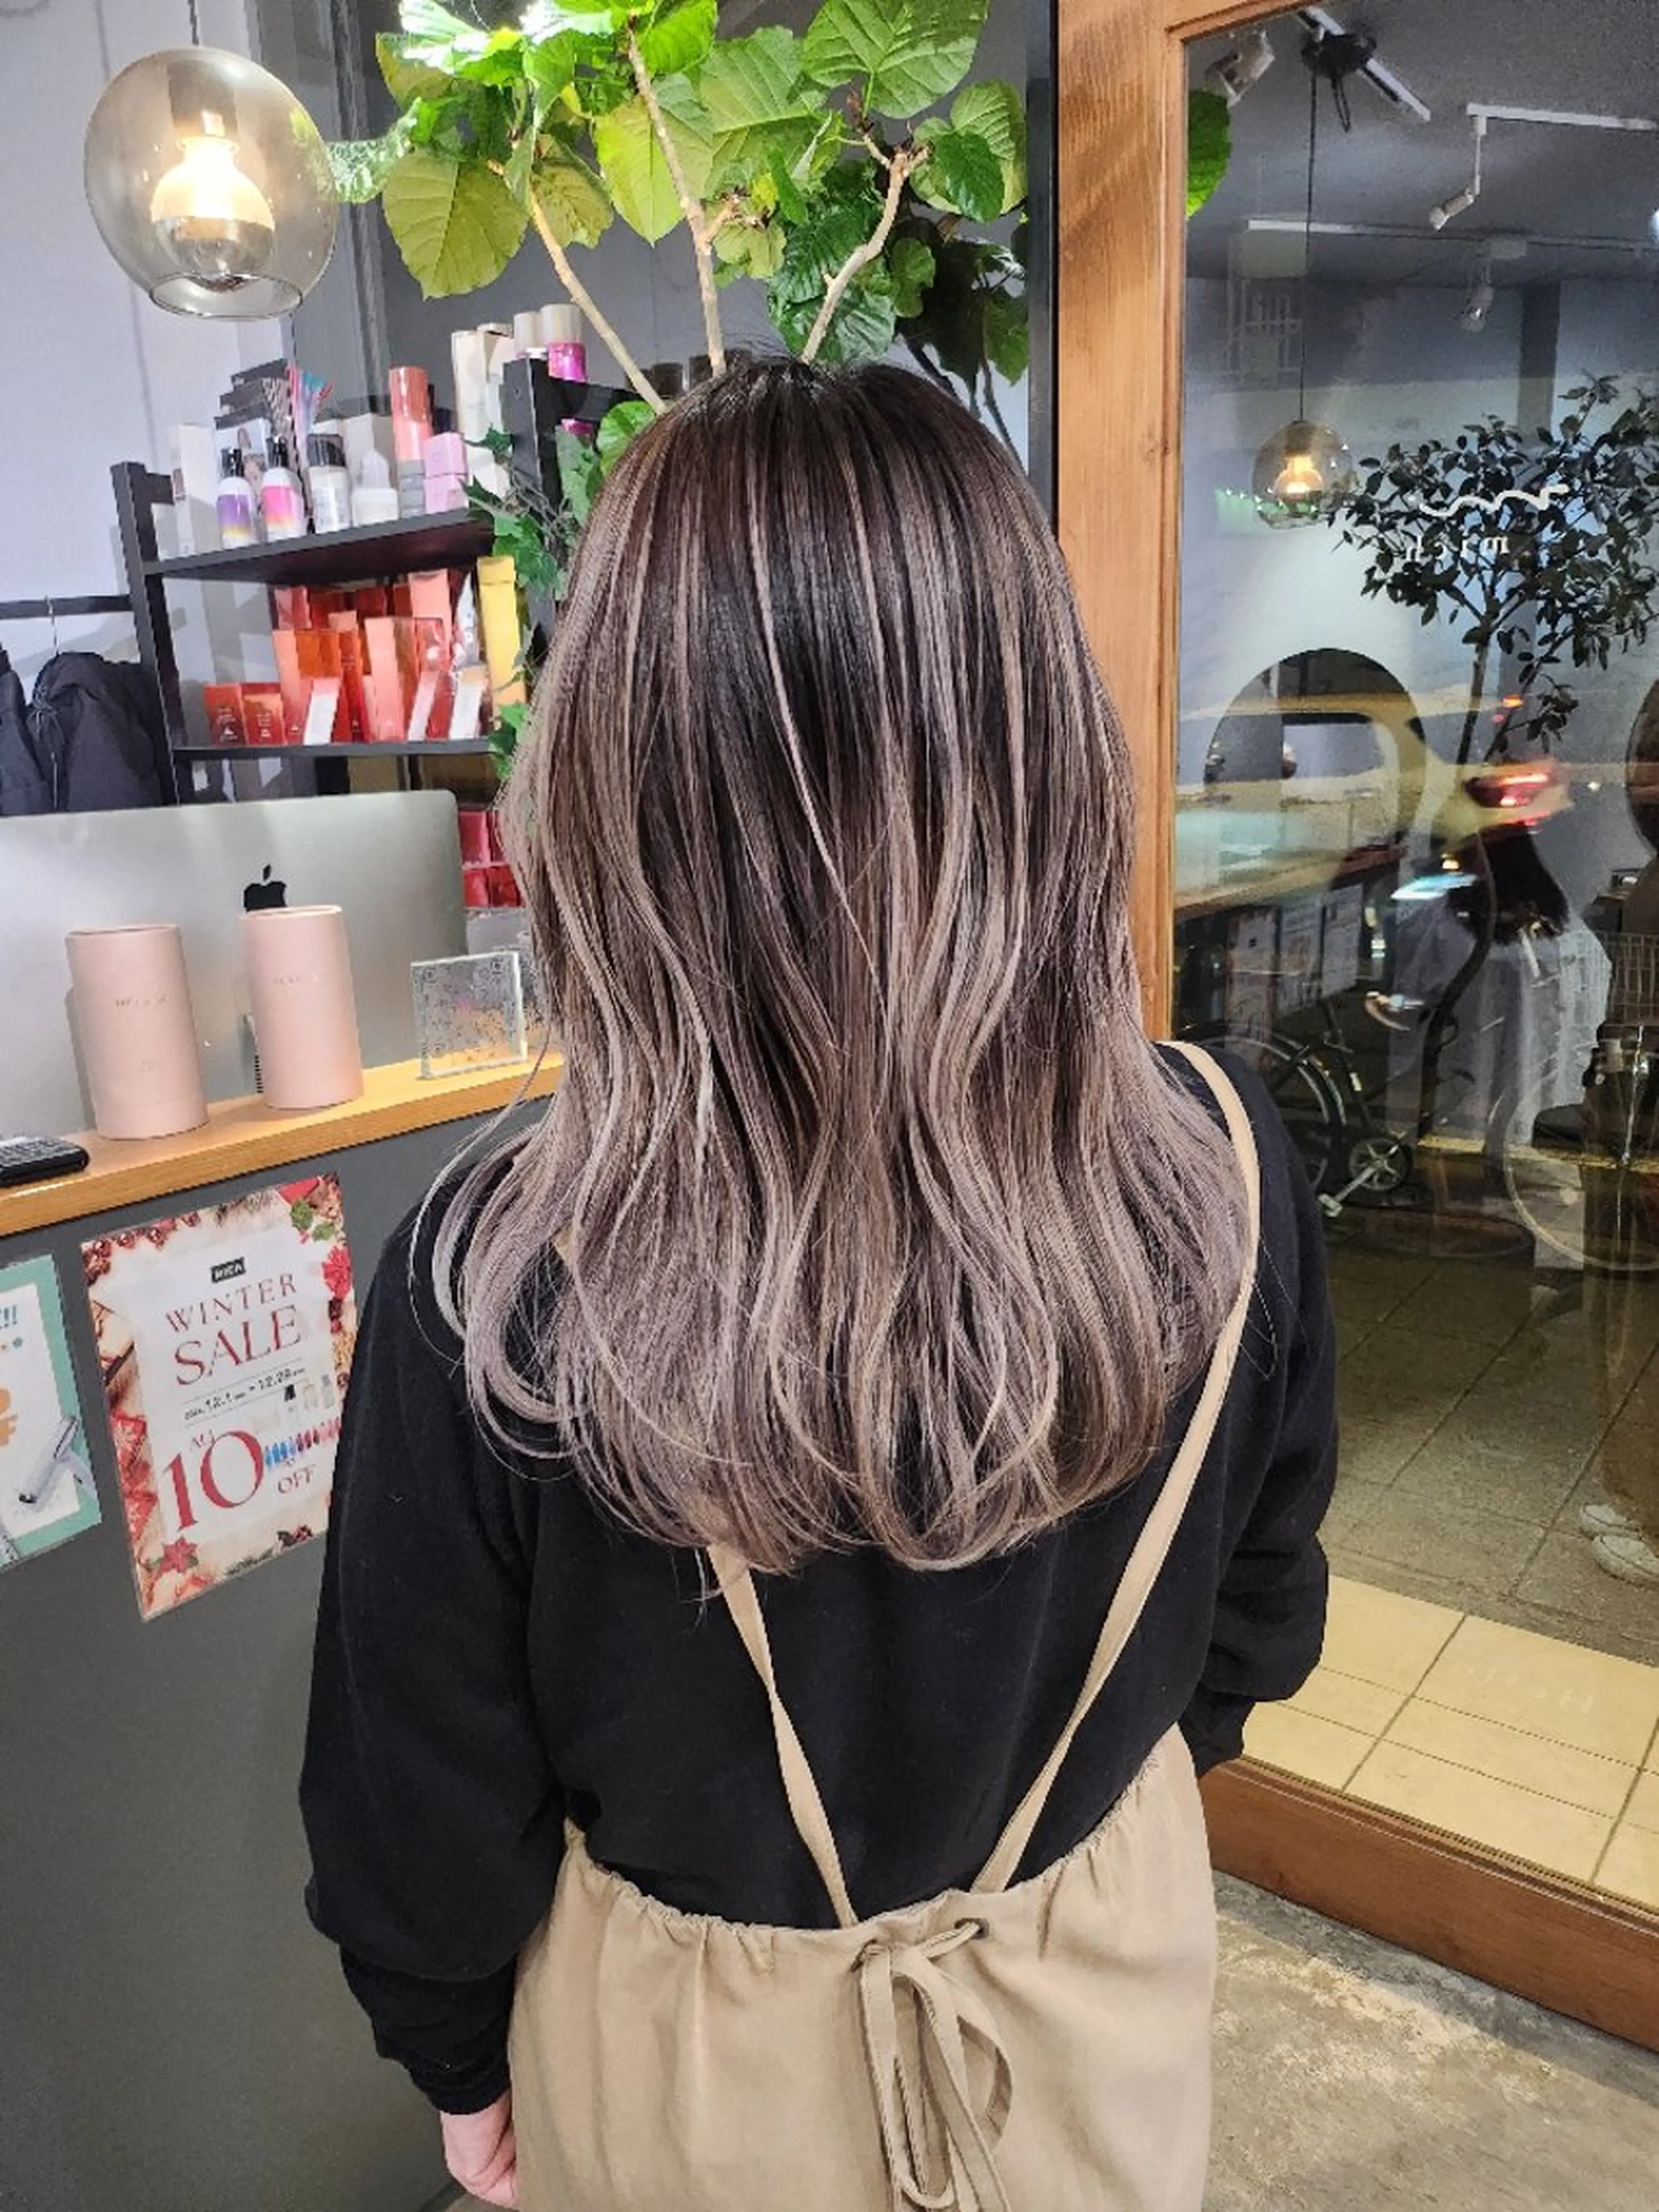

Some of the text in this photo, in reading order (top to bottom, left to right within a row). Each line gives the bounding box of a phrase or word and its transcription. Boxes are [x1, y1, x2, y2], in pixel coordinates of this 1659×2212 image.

[165, 1274, 296, 1332] WINTER
[174, 1304, 301, 1385] SALE
[162, 1430, 264, 1532] 10
[278, 1463, 316, 1494] OFF
